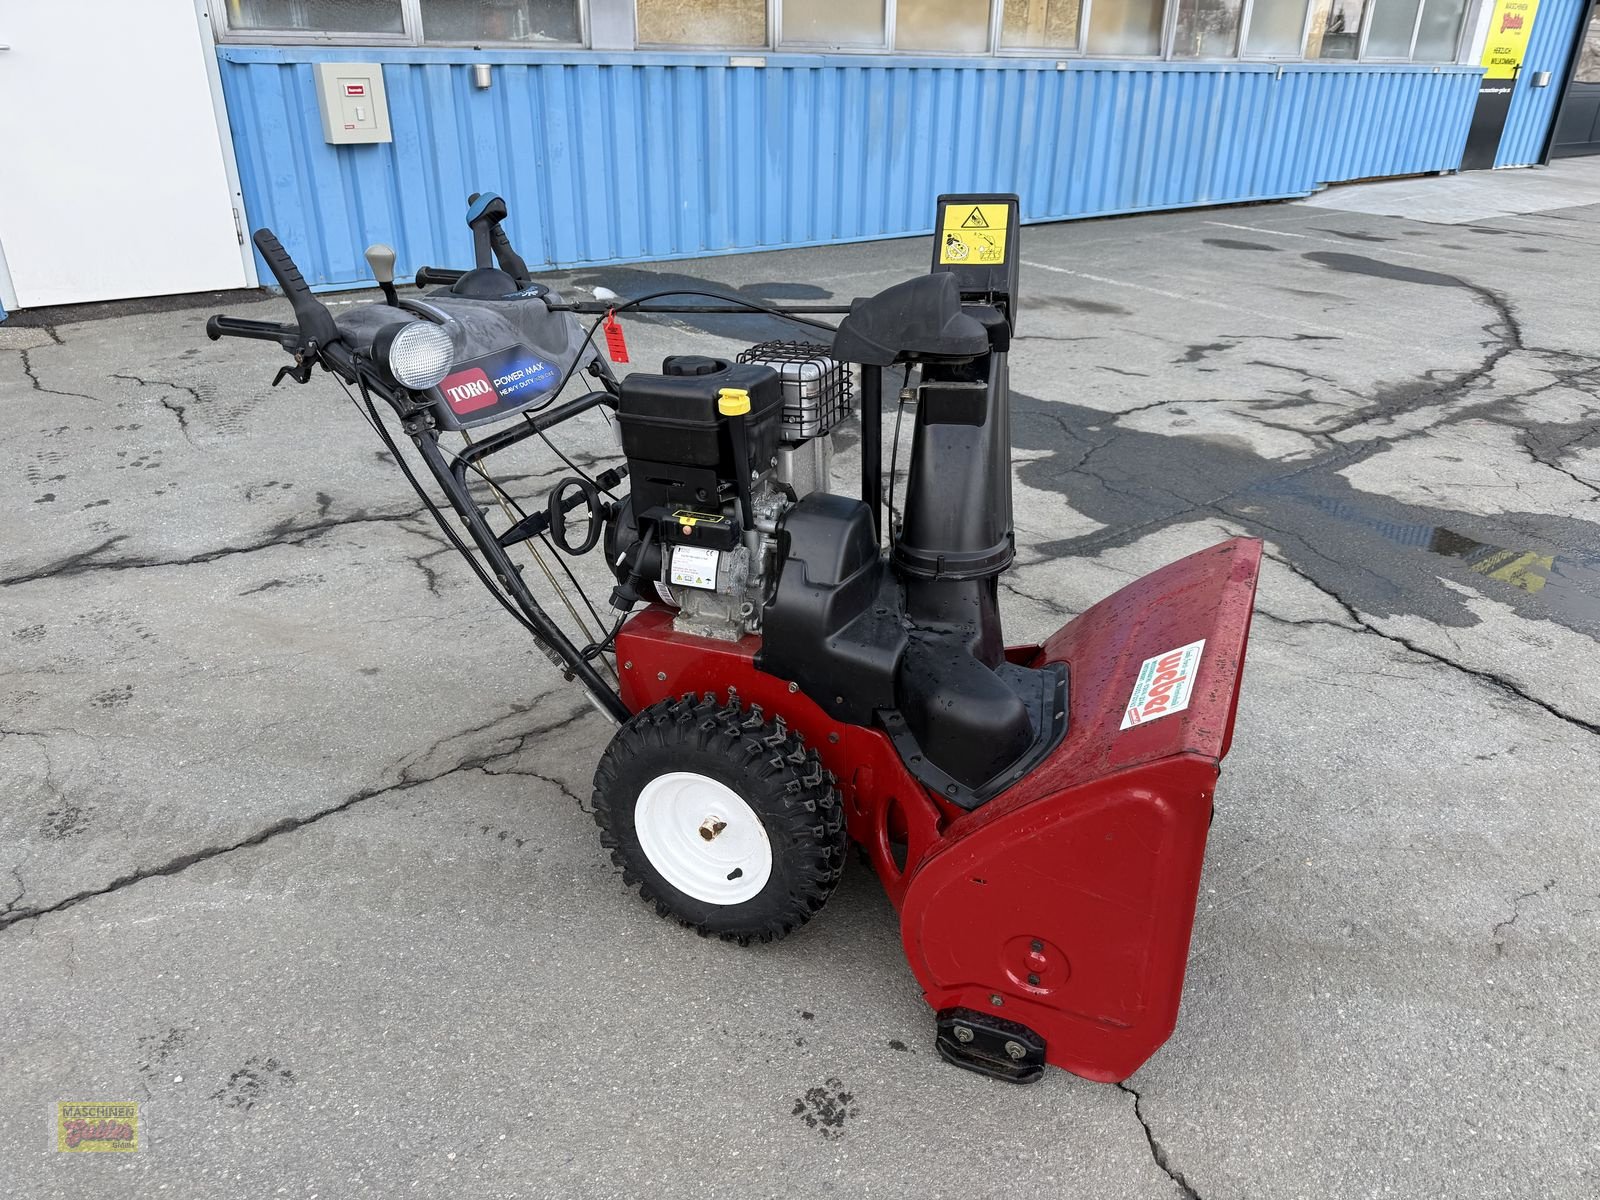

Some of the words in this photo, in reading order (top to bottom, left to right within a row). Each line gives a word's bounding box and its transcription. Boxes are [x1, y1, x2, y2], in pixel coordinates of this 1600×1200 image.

[493, 370, 525, 388] POWER
[525, 362, 545, 375] MAX
[499, 385, 519, 397] HEAVY
[519, 378, 534, 388] DUTY
[1142, 651, 1187, 717] weber
